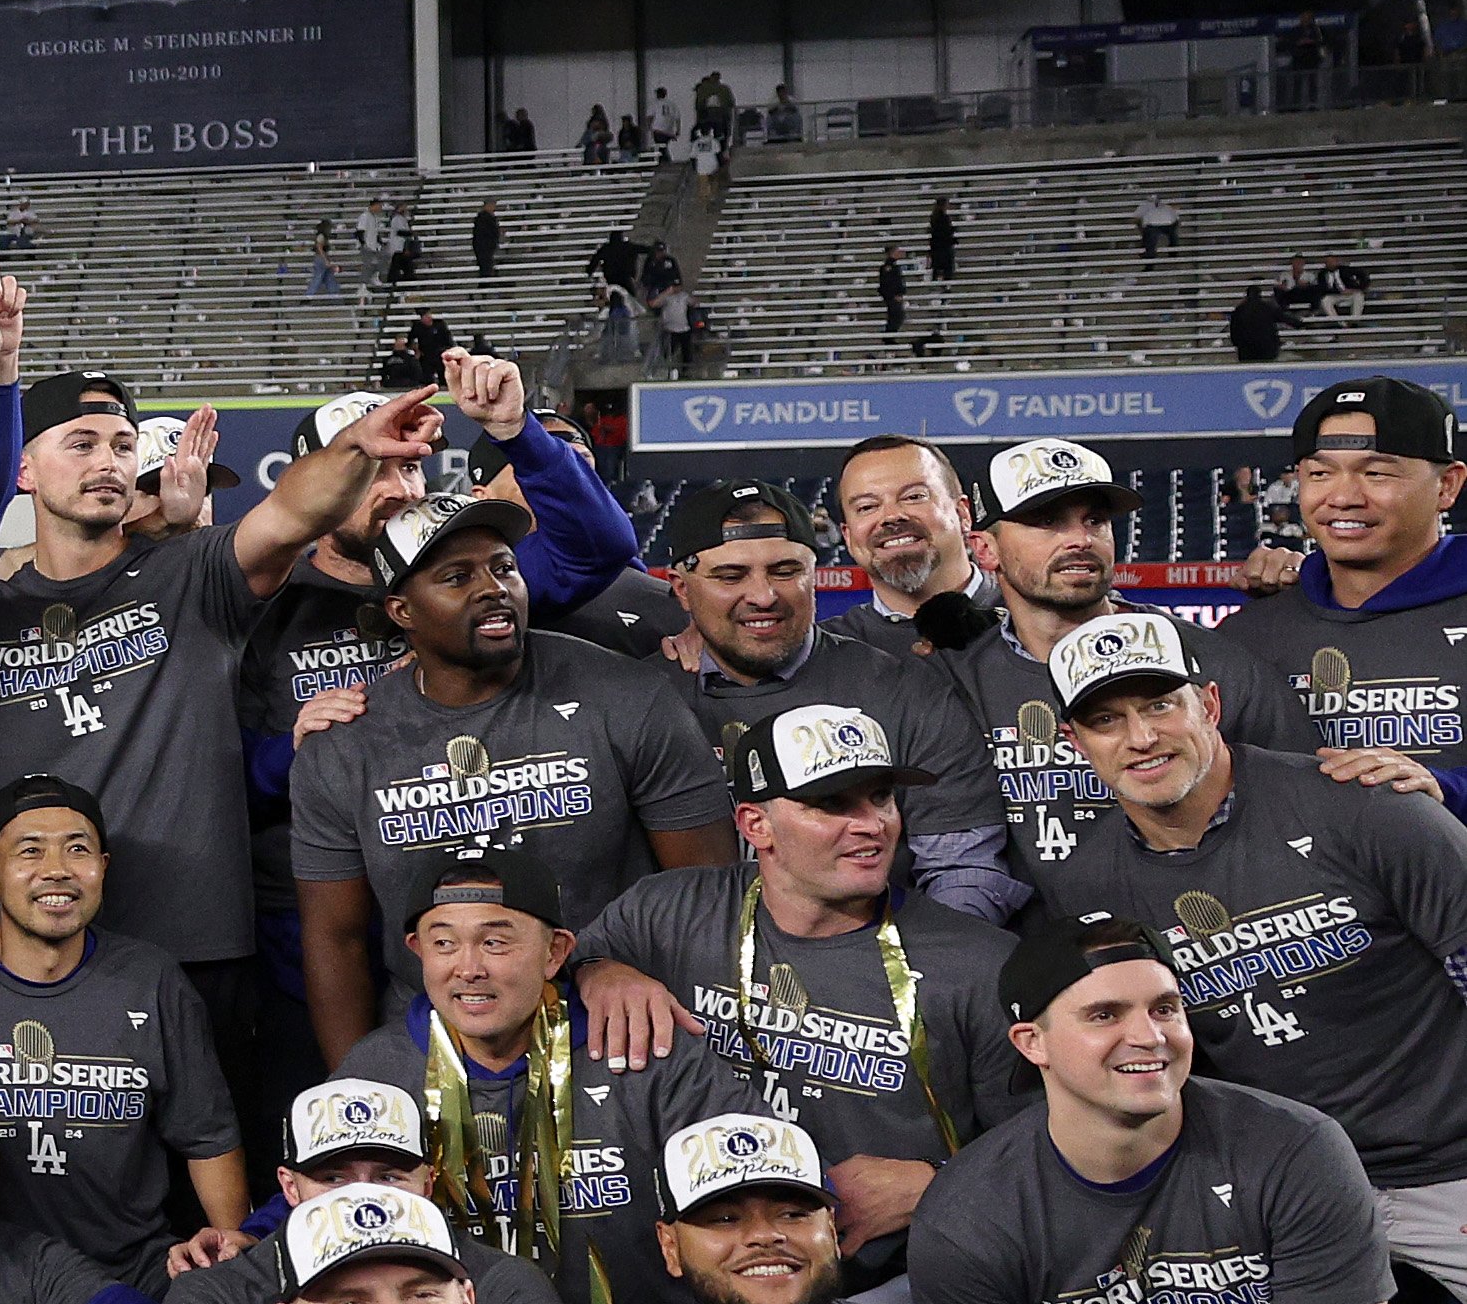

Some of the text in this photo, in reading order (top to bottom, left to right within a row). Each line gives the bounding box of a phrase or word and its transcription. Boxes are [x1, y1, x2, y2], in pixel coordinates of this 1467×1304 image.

[27, 24, 324, 57] GEORGE M. STEINBRENNER III
[126, 64, 223, 84] 1930-2010
[71, 118, 280, 158] THE BOSS
[733, 400, 880, 424] FANDUEL
[1007, 392, 1164, 417] FANDUEL
[1166, 565, 1199, 585] HIT
[75, 602, 160, 655] SERIES
[1356, 684, 1463, 714] SERIES
[1234, 895, 1357, 952] SERIES
